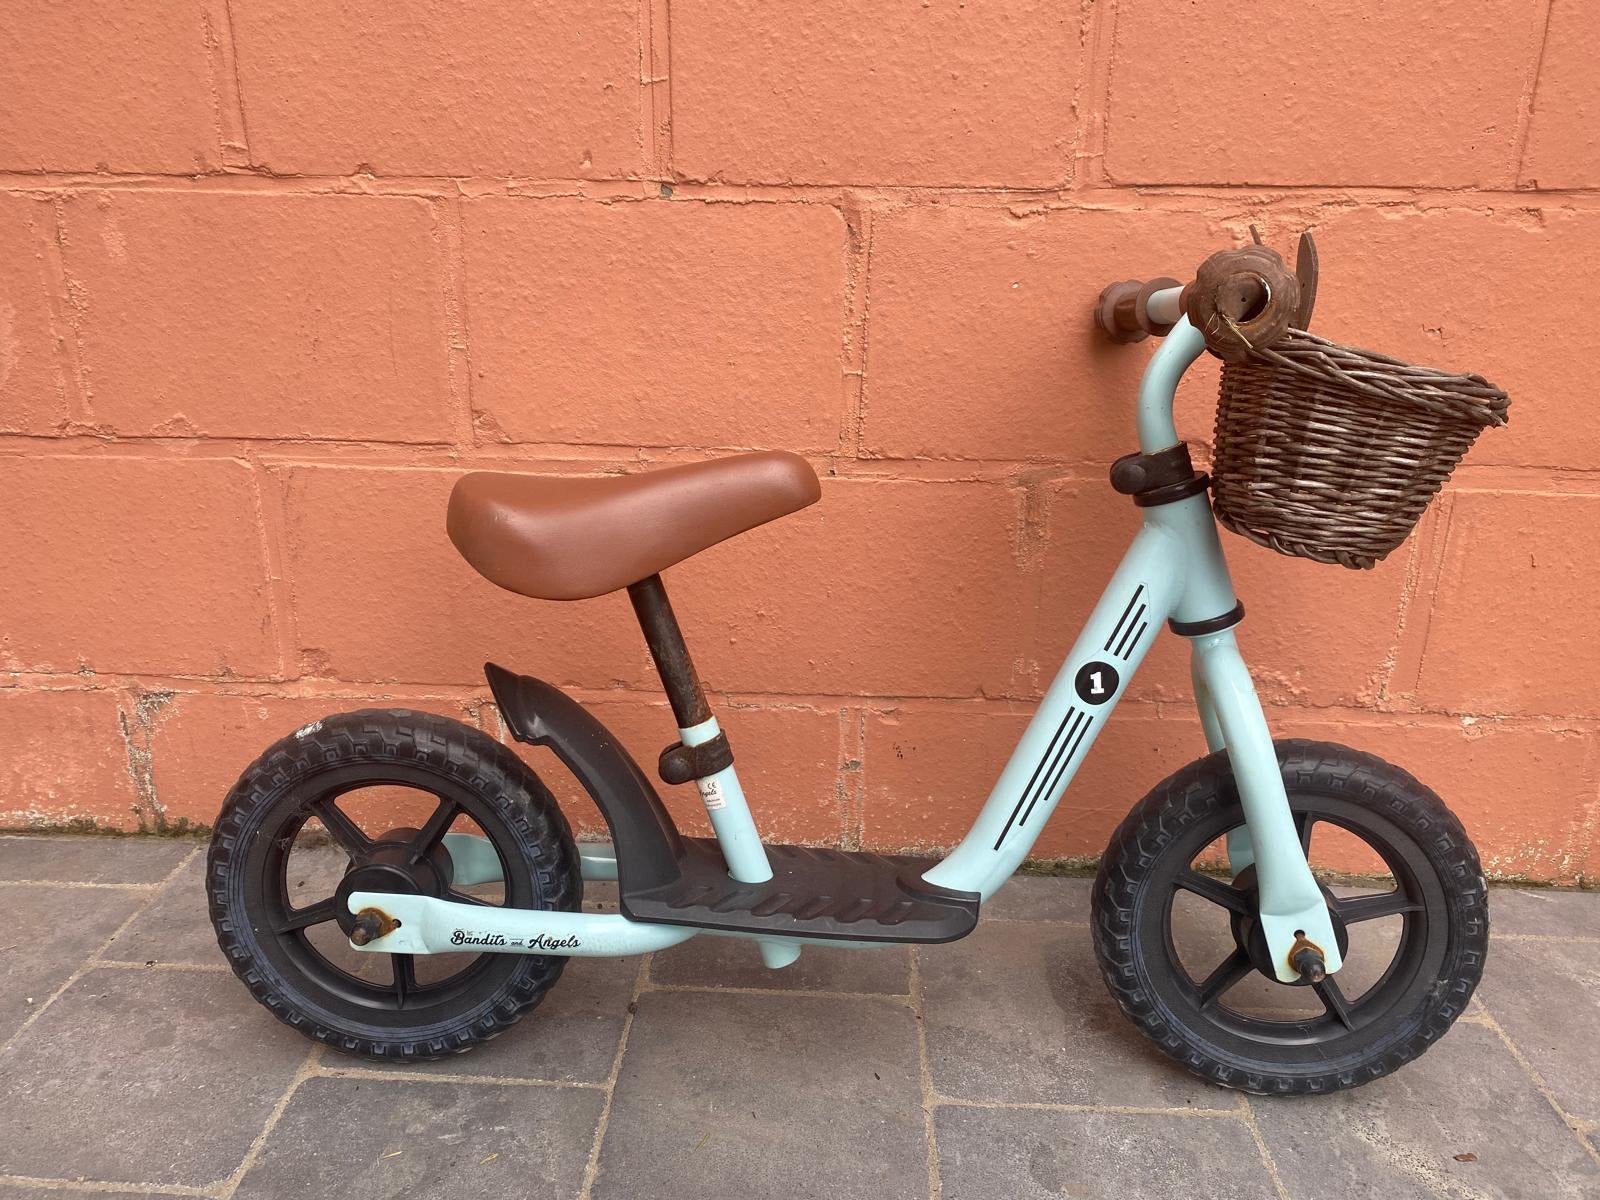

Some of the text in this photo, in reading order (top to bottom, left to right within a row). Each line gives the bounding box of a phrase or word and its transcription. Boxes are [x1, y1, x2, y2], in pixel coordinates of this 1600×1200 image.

[1090, 671, 1105, 694] 1
[450, 930, 507, 946] Bandits
[527, 933, 581, 950] Angels
